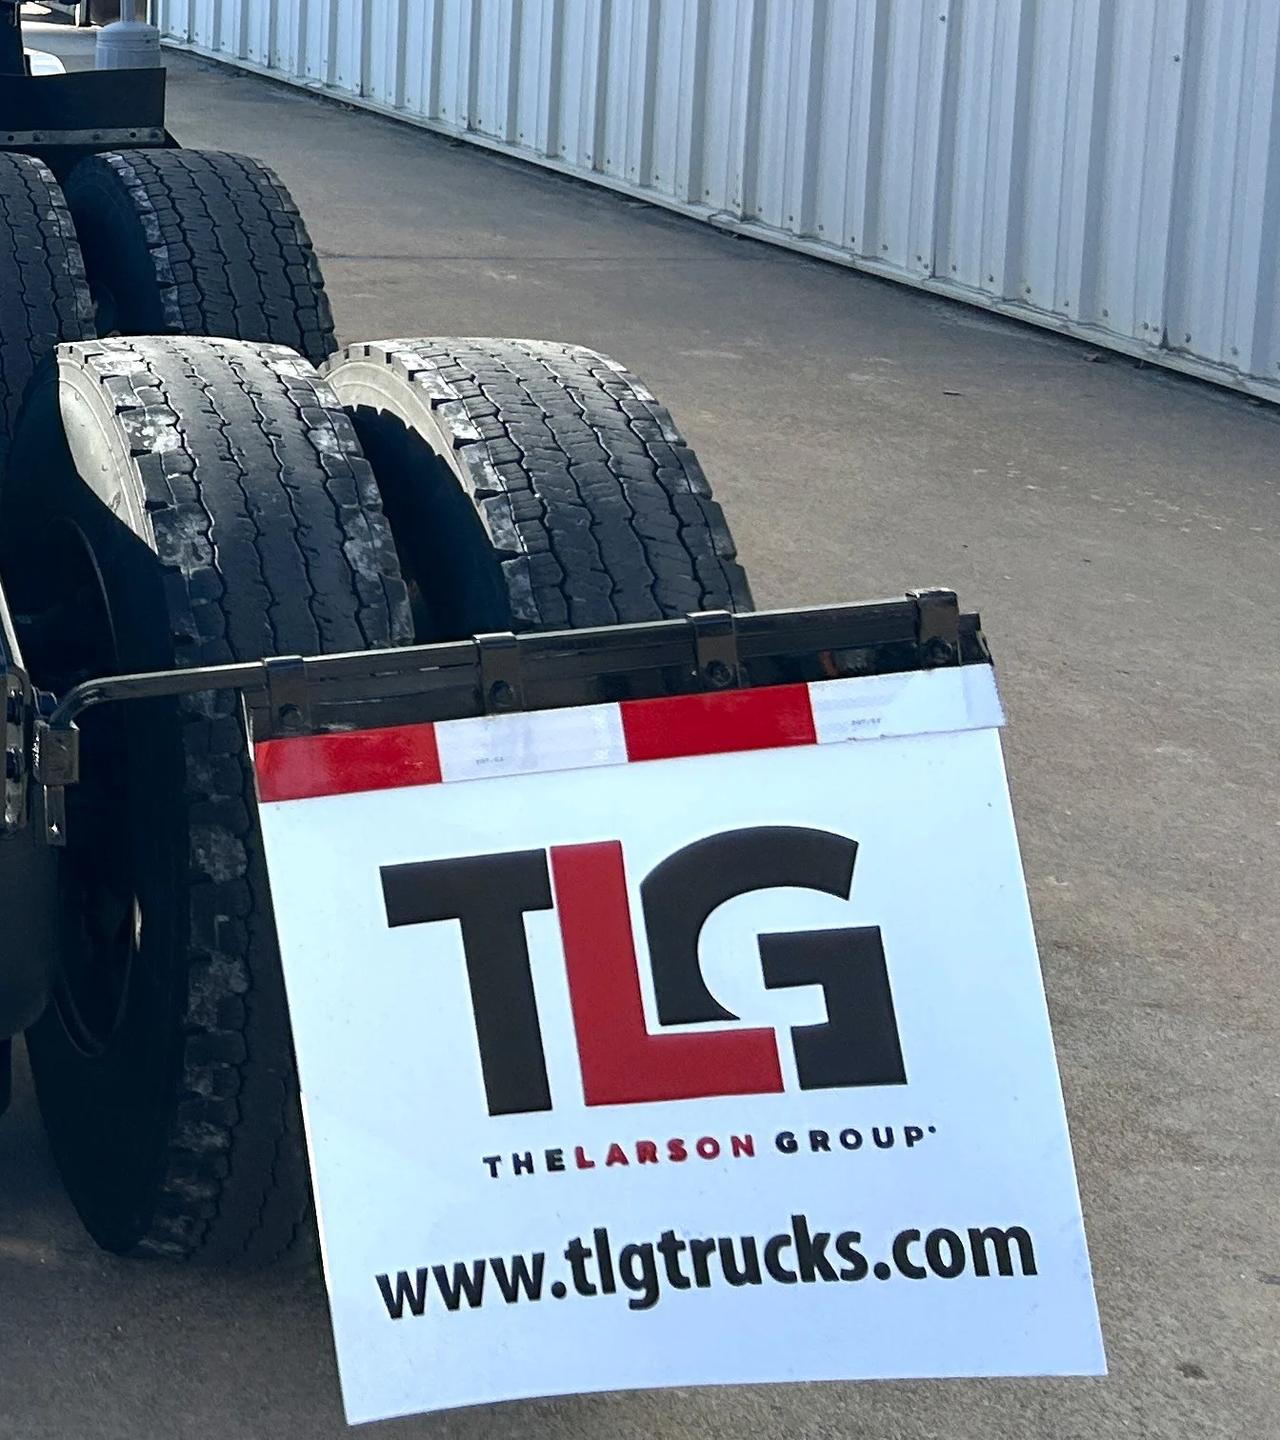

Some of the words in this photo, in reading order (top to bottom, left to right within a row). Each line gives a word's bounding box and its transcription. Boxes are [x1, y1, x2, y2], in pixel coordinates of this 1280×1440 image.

[378, 825, 909, 1118] TLG
[774, 1125, 924, 1155] GROUP
[374, 1213, 1039, 1321] www.tlgtrucks.com
